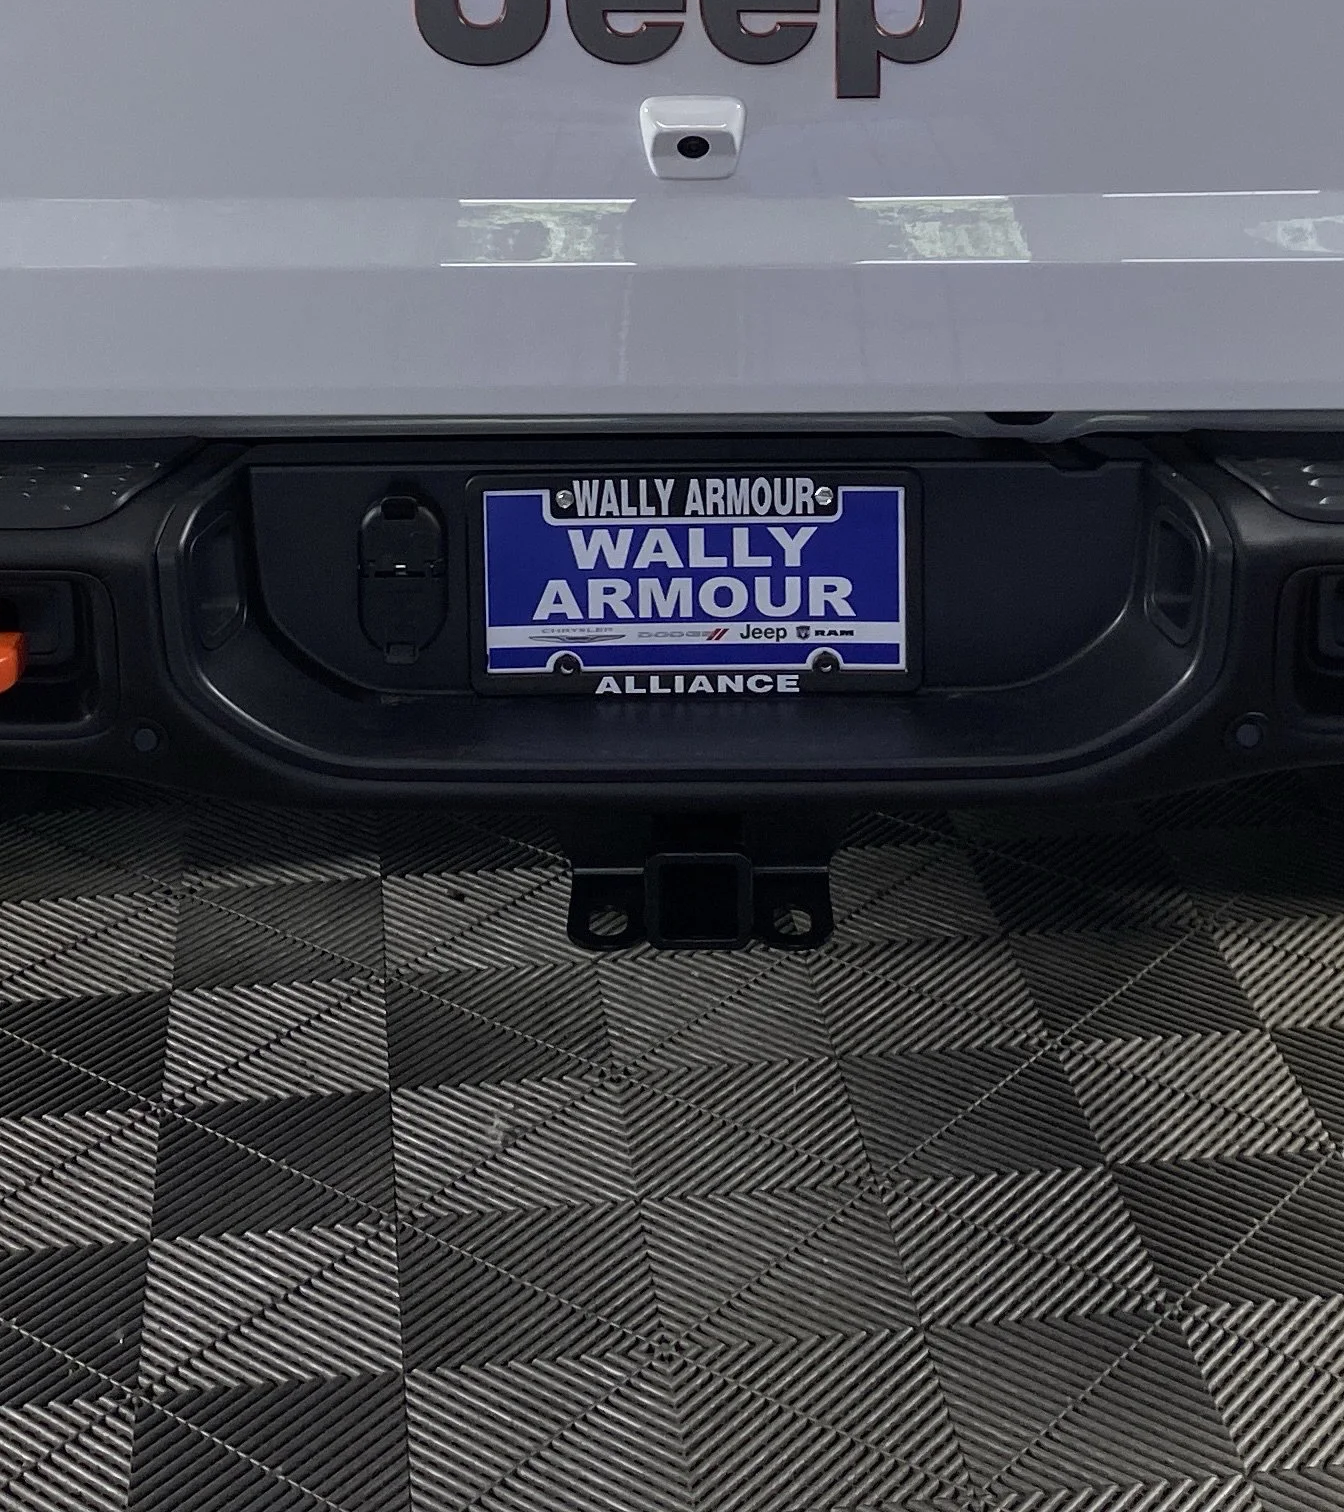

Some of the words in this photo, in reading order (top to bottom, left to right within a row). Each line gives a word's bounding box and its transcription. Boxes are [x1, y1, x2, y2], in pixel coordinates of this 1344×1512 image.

[572, 478, 675, 517] WALLY
[684, 477, 815, 516] ARMOUR
[567, 526, 818, 570] WALLY
[532, 576, 857, 621] ARMOUR
[541, 626, 614, 634] CHRYSLER
[739, 623, 788, 642] Jeep
[814, 629, 855, 637] RAM
[595, 675, 800, 694] ALLIANCE
